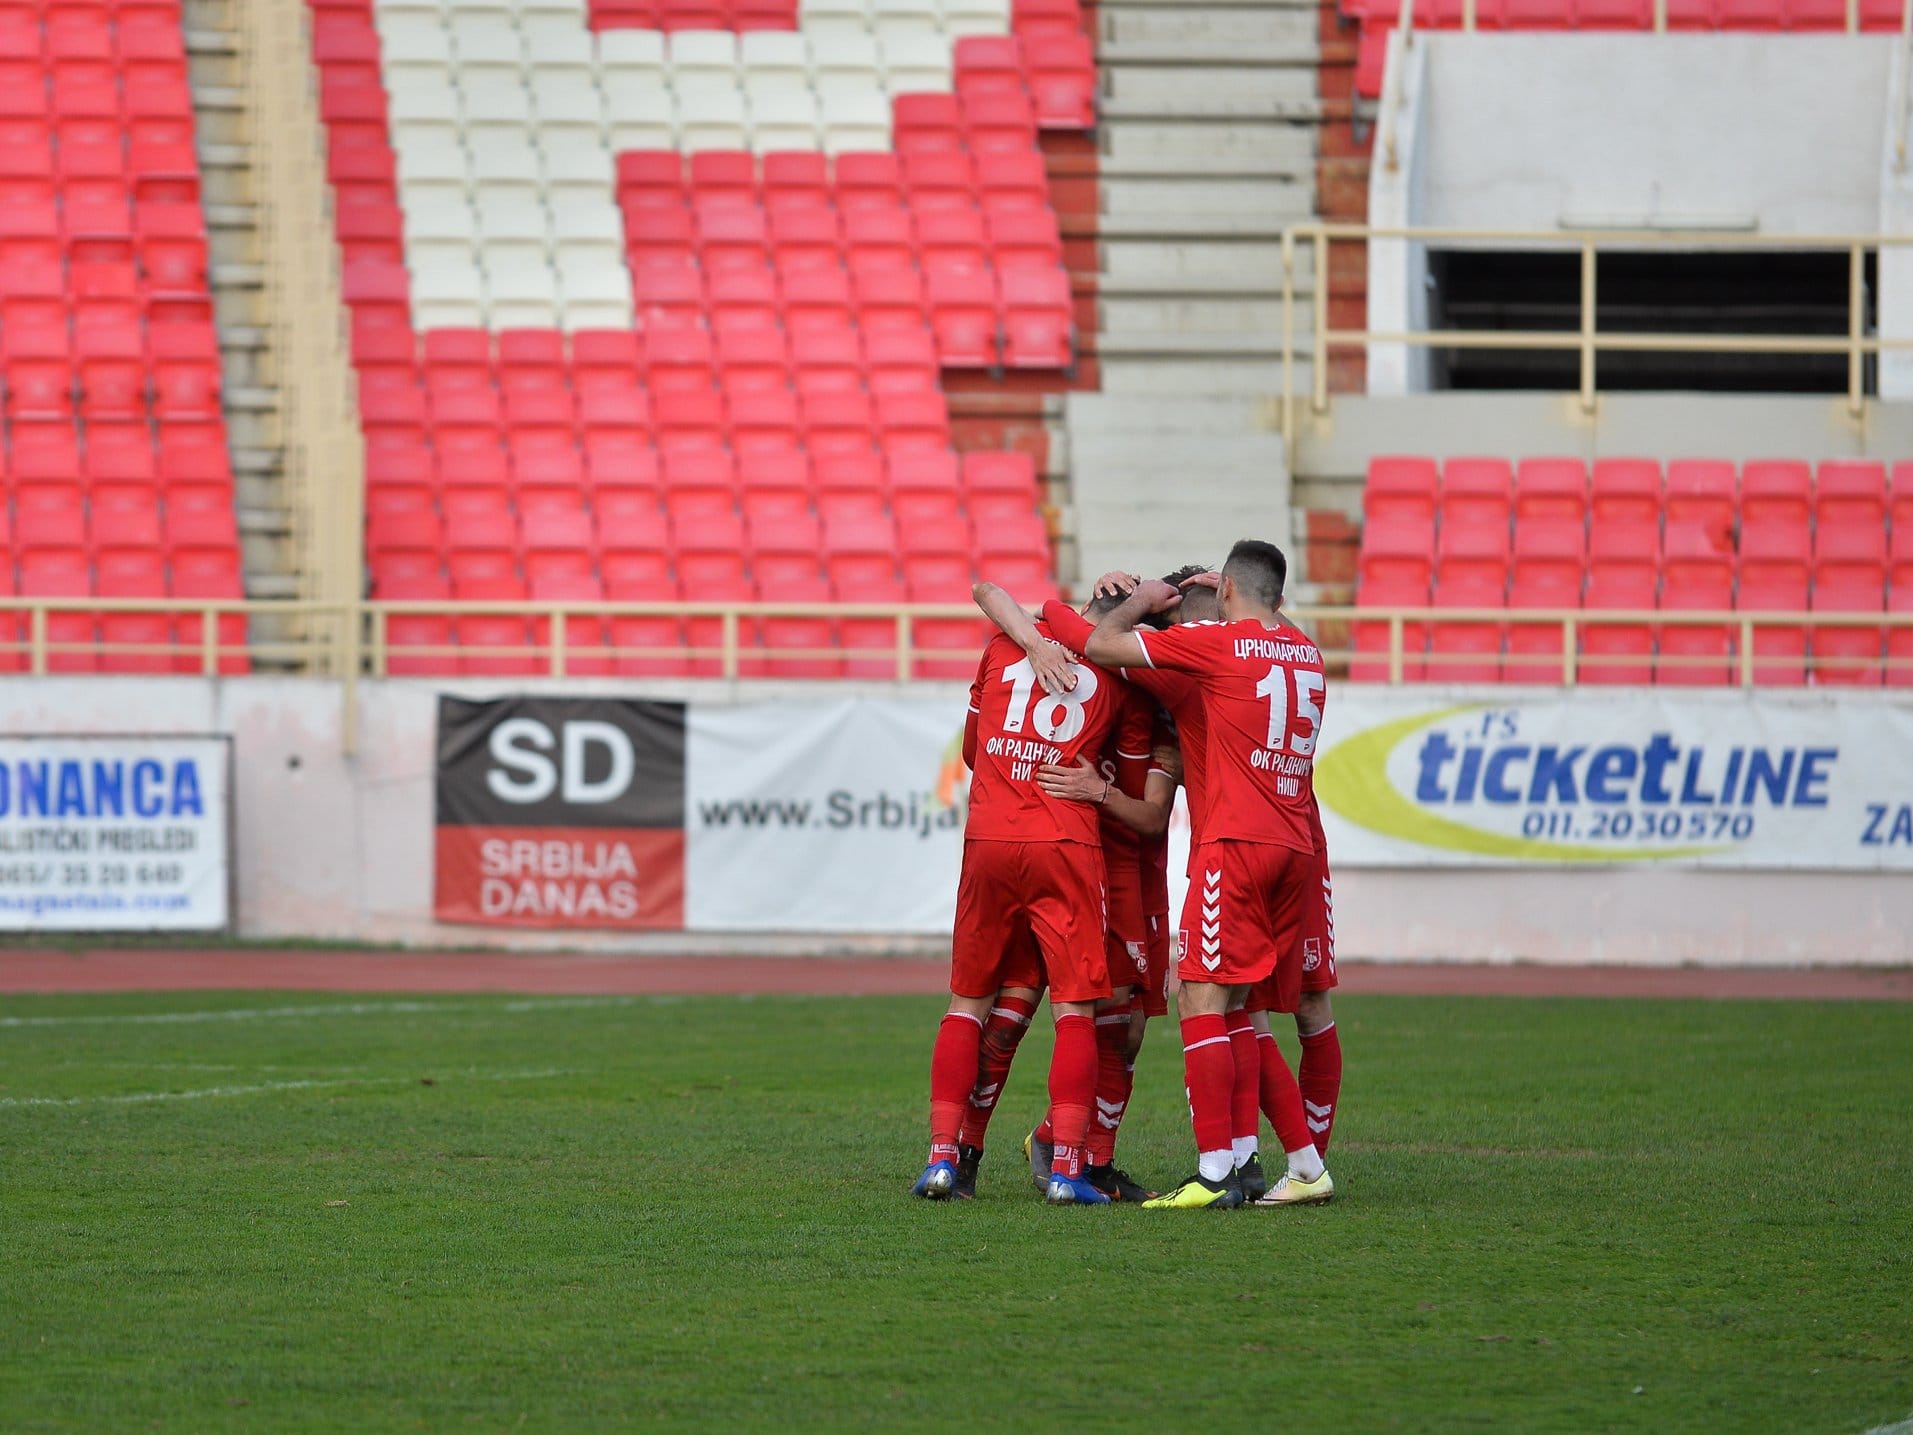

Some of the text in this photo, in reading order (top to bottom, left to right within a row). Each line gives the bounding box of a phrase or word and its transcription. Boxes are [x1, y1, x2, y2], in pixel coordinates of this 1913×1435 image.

[1001, 654, 1098, 743] 18
[1256, 664, 1324, 756] 15
[486, 718, 635, 803] SD
[986, 736, 1003, 755] ФК
[1250, 748, 1271, 770] ФК
[1011, 761, 1035, 782] НИ
[1277, 775, 1299, 797] НИШ
[700, 790, 968, 838] www.Srbija
[480, 839, 637, 878] SRBIJA
[480, 880, 638, 919] DANAS
